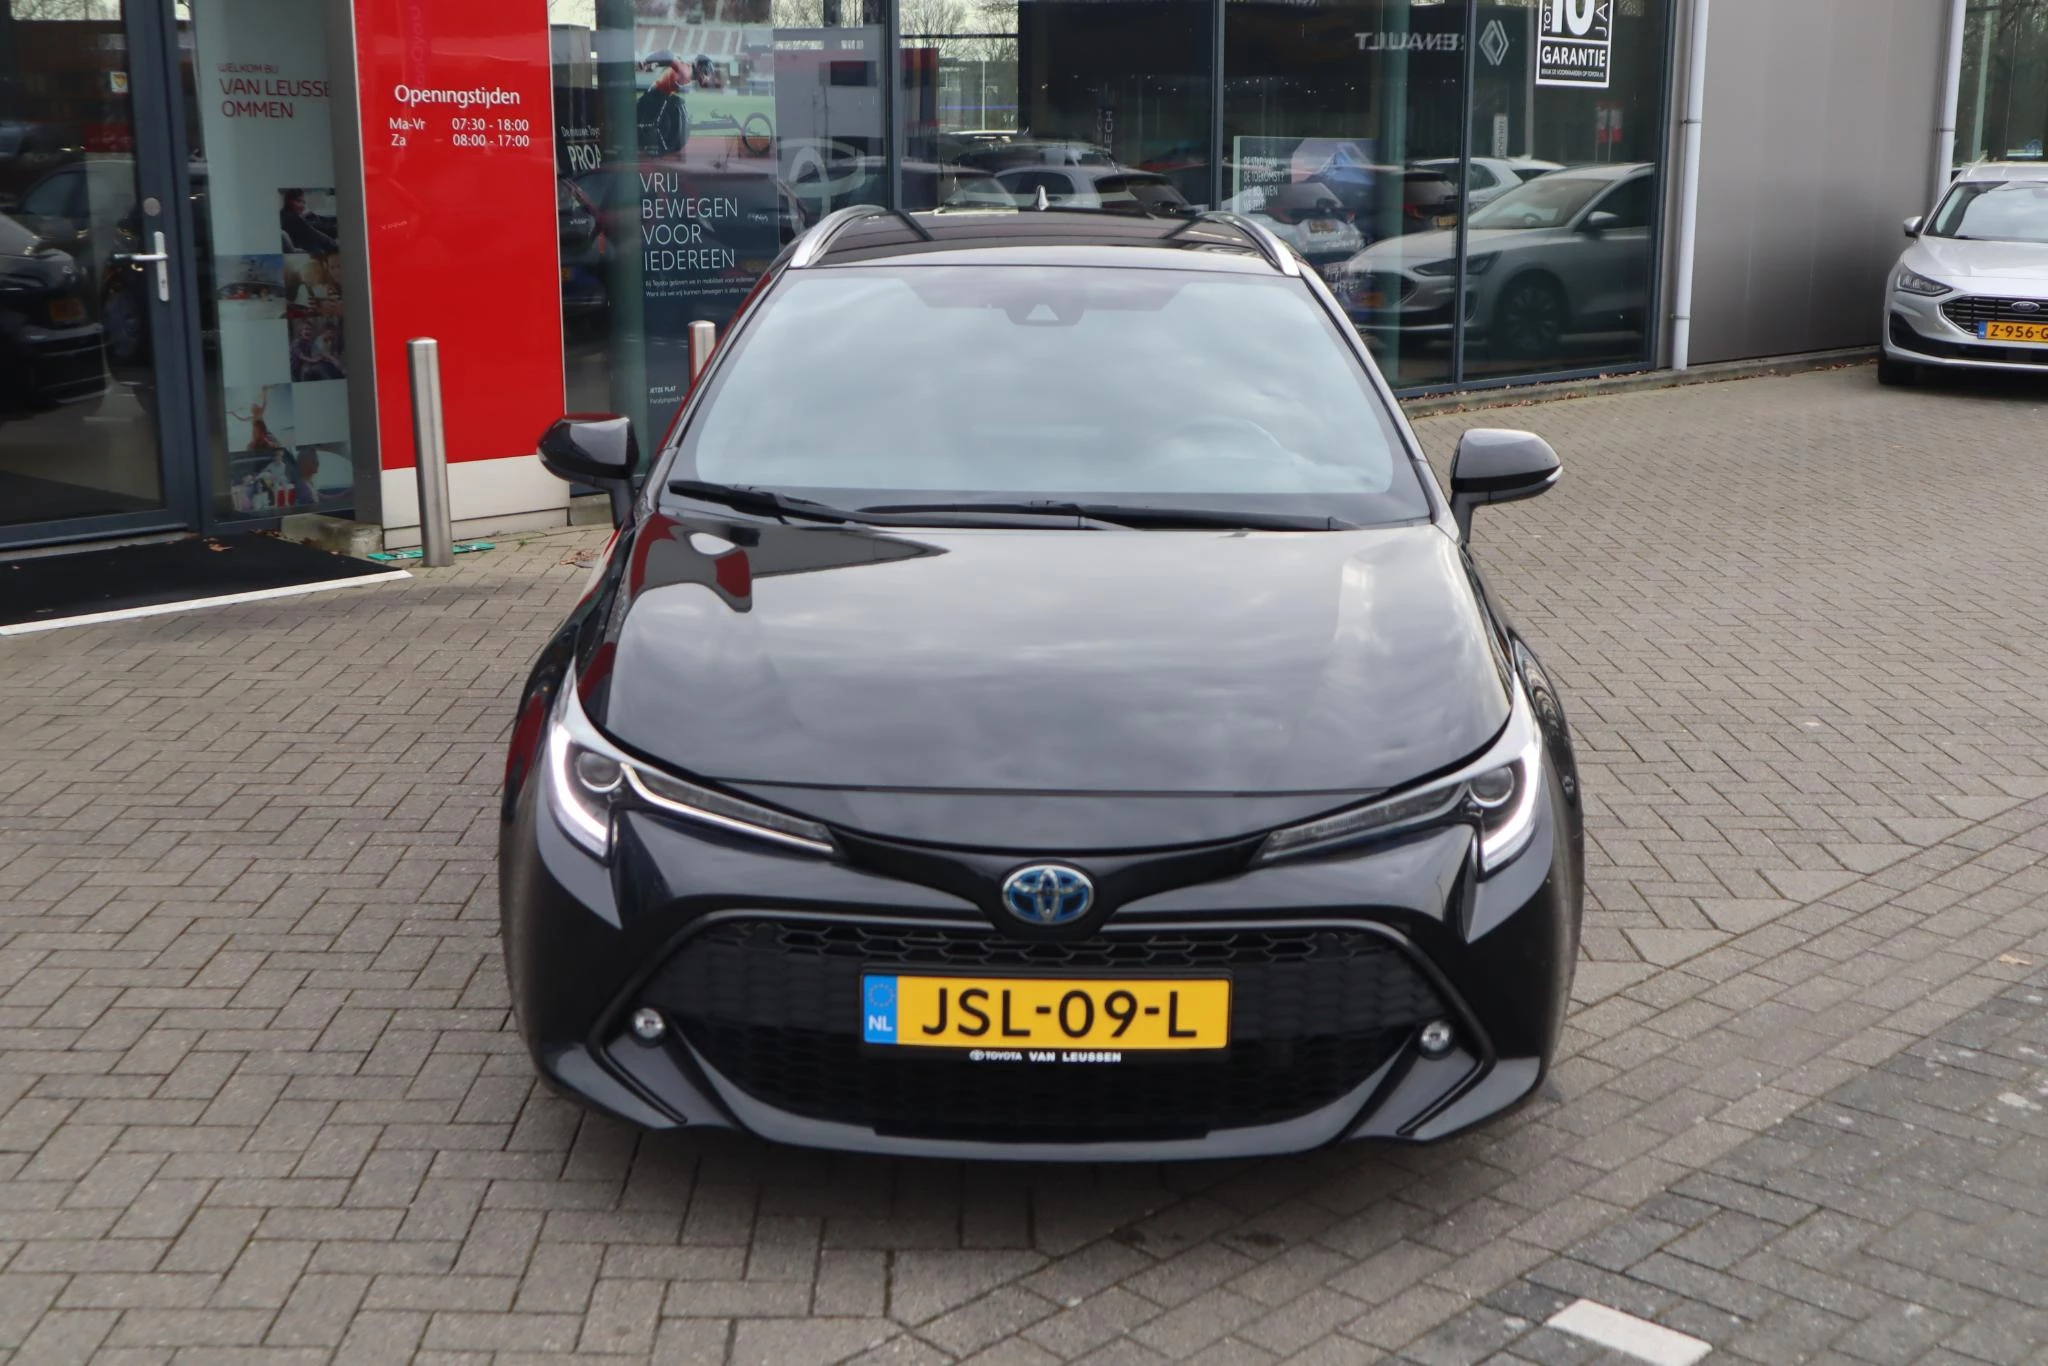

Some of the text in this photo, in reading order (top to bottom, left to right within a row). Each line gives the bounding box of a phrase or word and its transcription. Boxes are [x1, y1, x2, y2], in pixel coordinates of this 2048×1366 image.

[1543, 4, 1552, 31] TOT
[1552, 0, 1595, 35] 10
[1541, 45, 1606, 67] GARANTIE
[219, 78, 259, 96] VAN
[394, 84, 521, 109] Openingstijden
[222, 100, 294, 118] OMMEN
[389, 117, 425, 130] Ma-Vr
[452, 118, 486, 130] 07:30
[497, 119, 529, 131] 18:00
[391, 134, 406, 146] Za
[453, 134, 486, 146] 08:00
[497, 134, 529, 147] 17:00
[640, 172, 679, 193] VRIJ
[642, 197, 738, 219] BEWEGEN
[641, 224, 703, 245] VOOR
[644, 248, 735, 271] IEDEREEN
[868, 987, 1198, 1039] NL JSL-09-L
[985, 1051, 1122, 1063] TOYOTA VAN LEUSSEN
